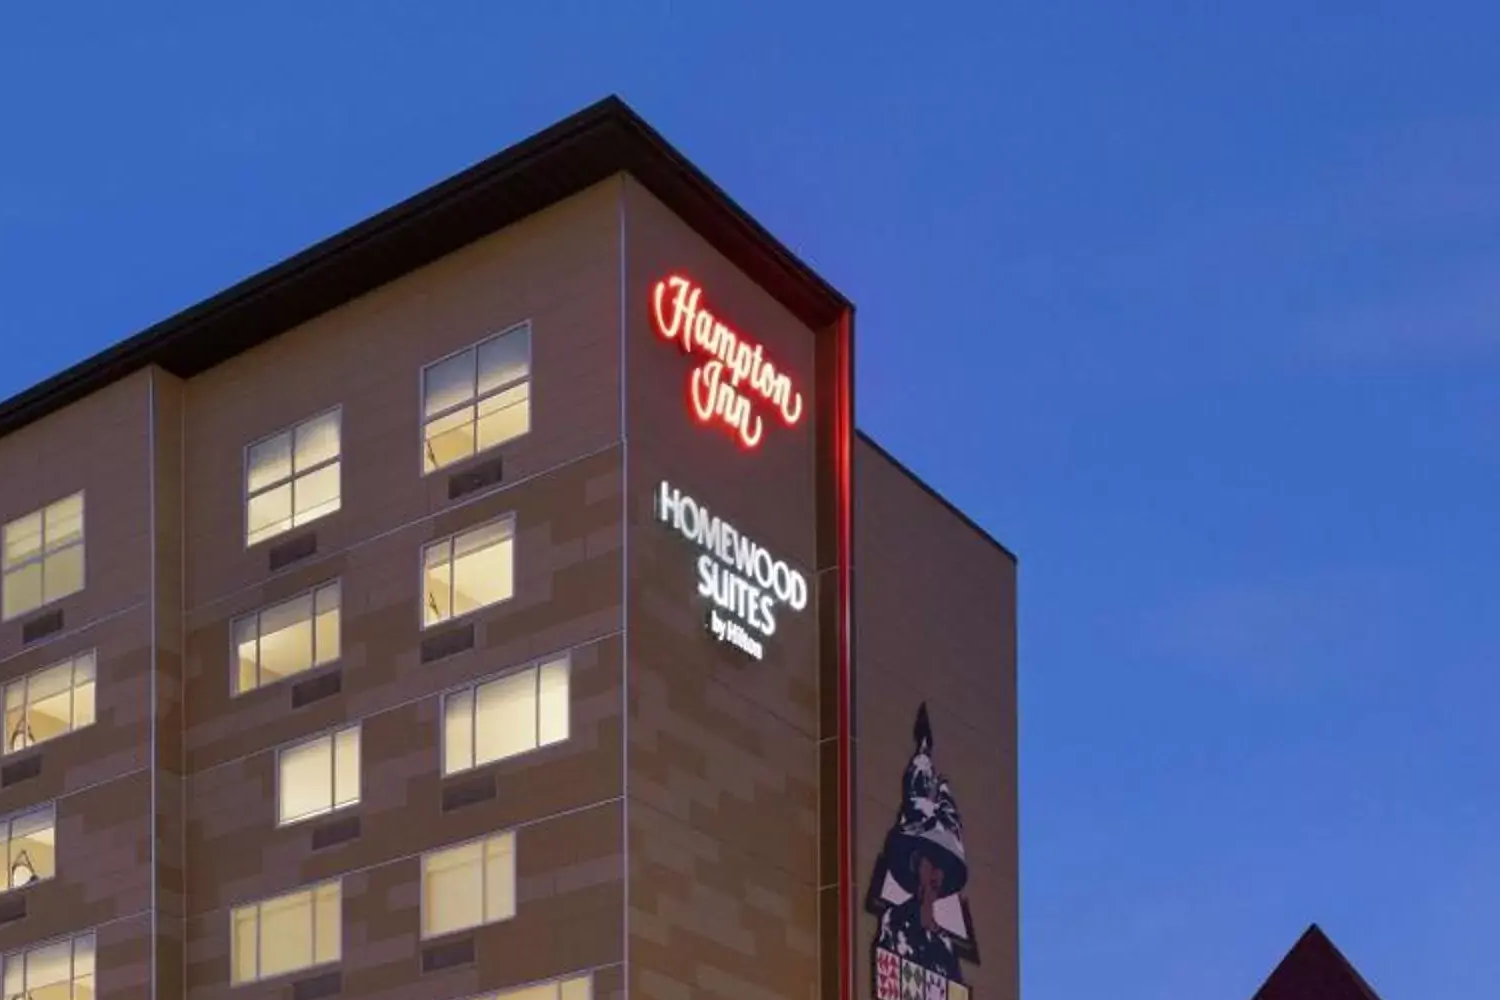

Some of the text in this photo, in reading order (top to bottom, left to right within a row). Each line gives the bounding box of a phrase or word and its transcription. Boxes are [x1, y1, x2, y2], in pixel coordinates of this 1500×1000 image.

[654, 275, 802, 424] Hampton
[691, 360, 763, 447] Inn
[660, 480, 808, 612] HOMEWOOD
[697, 554, 776, 636] SUITES
[711, 609, 726, 641] by
